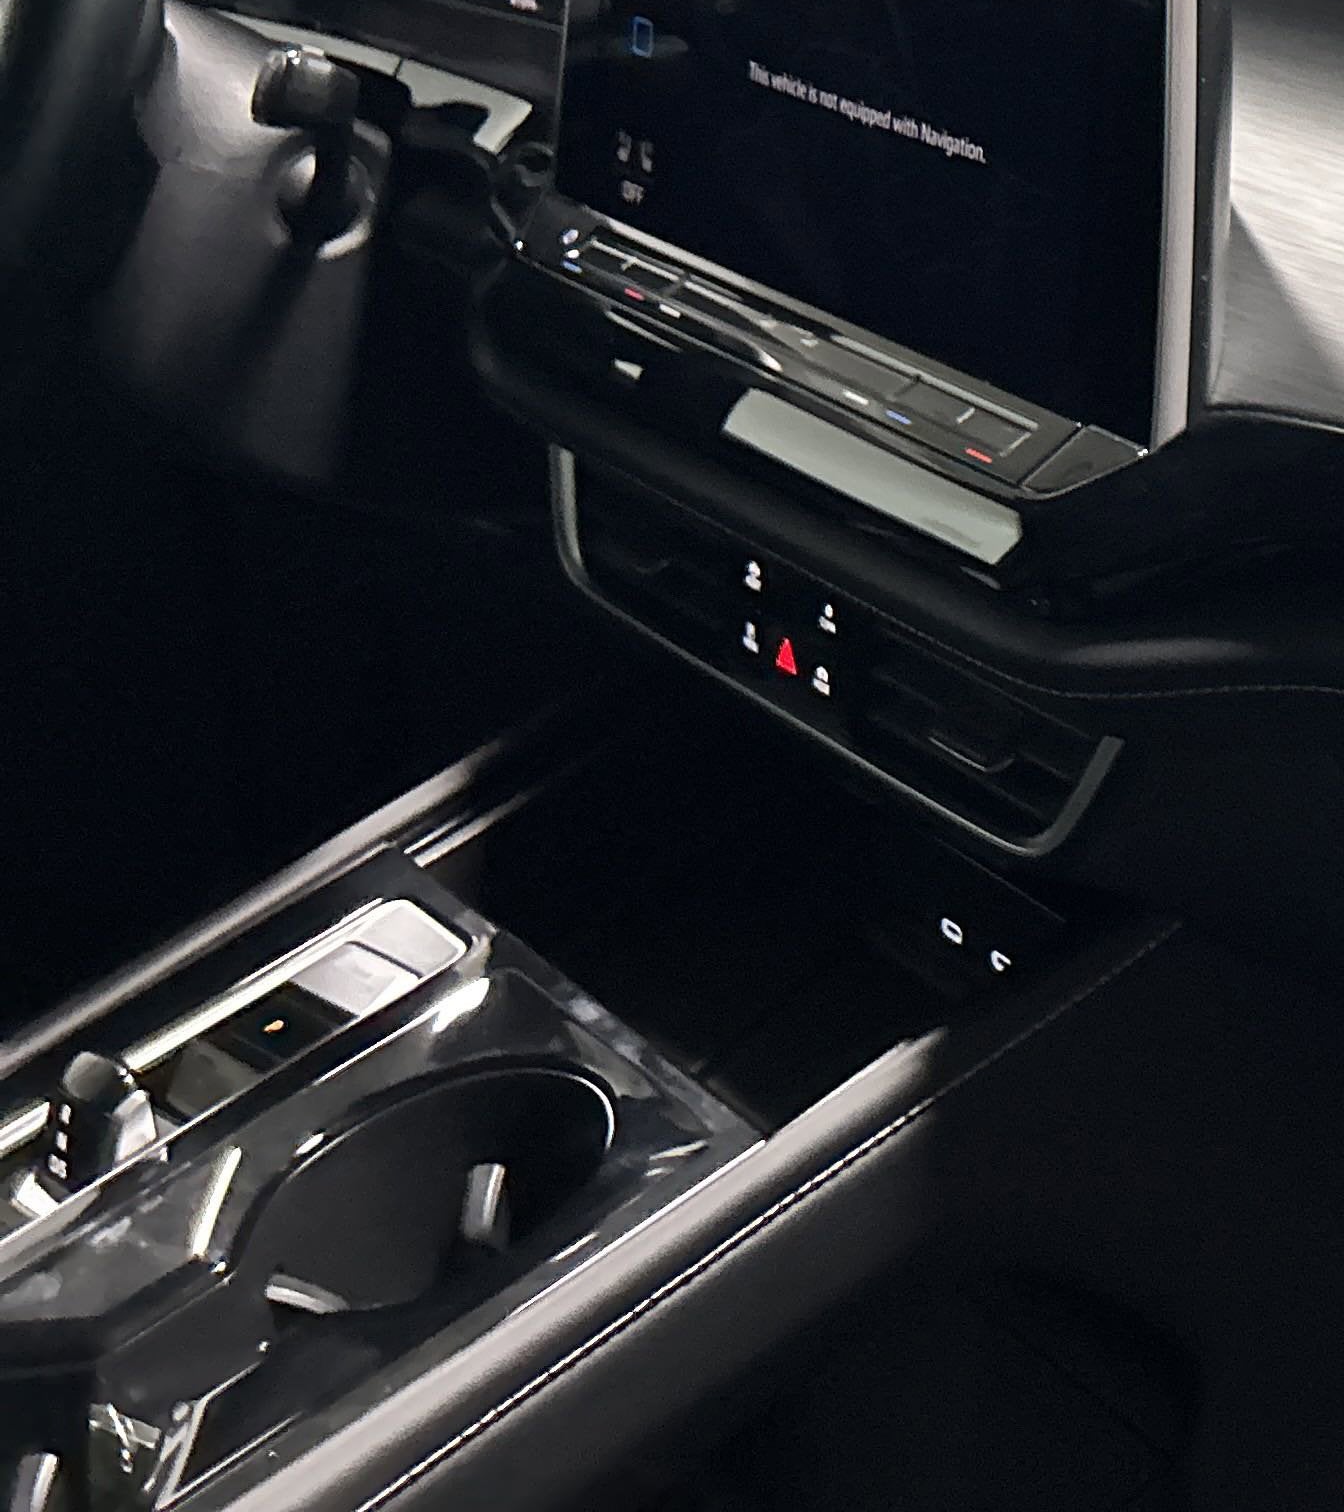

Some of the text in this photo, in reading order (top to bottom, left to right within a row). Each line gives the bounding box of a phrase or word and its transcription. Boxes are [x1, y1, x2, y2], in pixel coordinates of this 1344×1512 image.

[749, 60, 986, 164] This vehicle is not equipped with Navigation.
